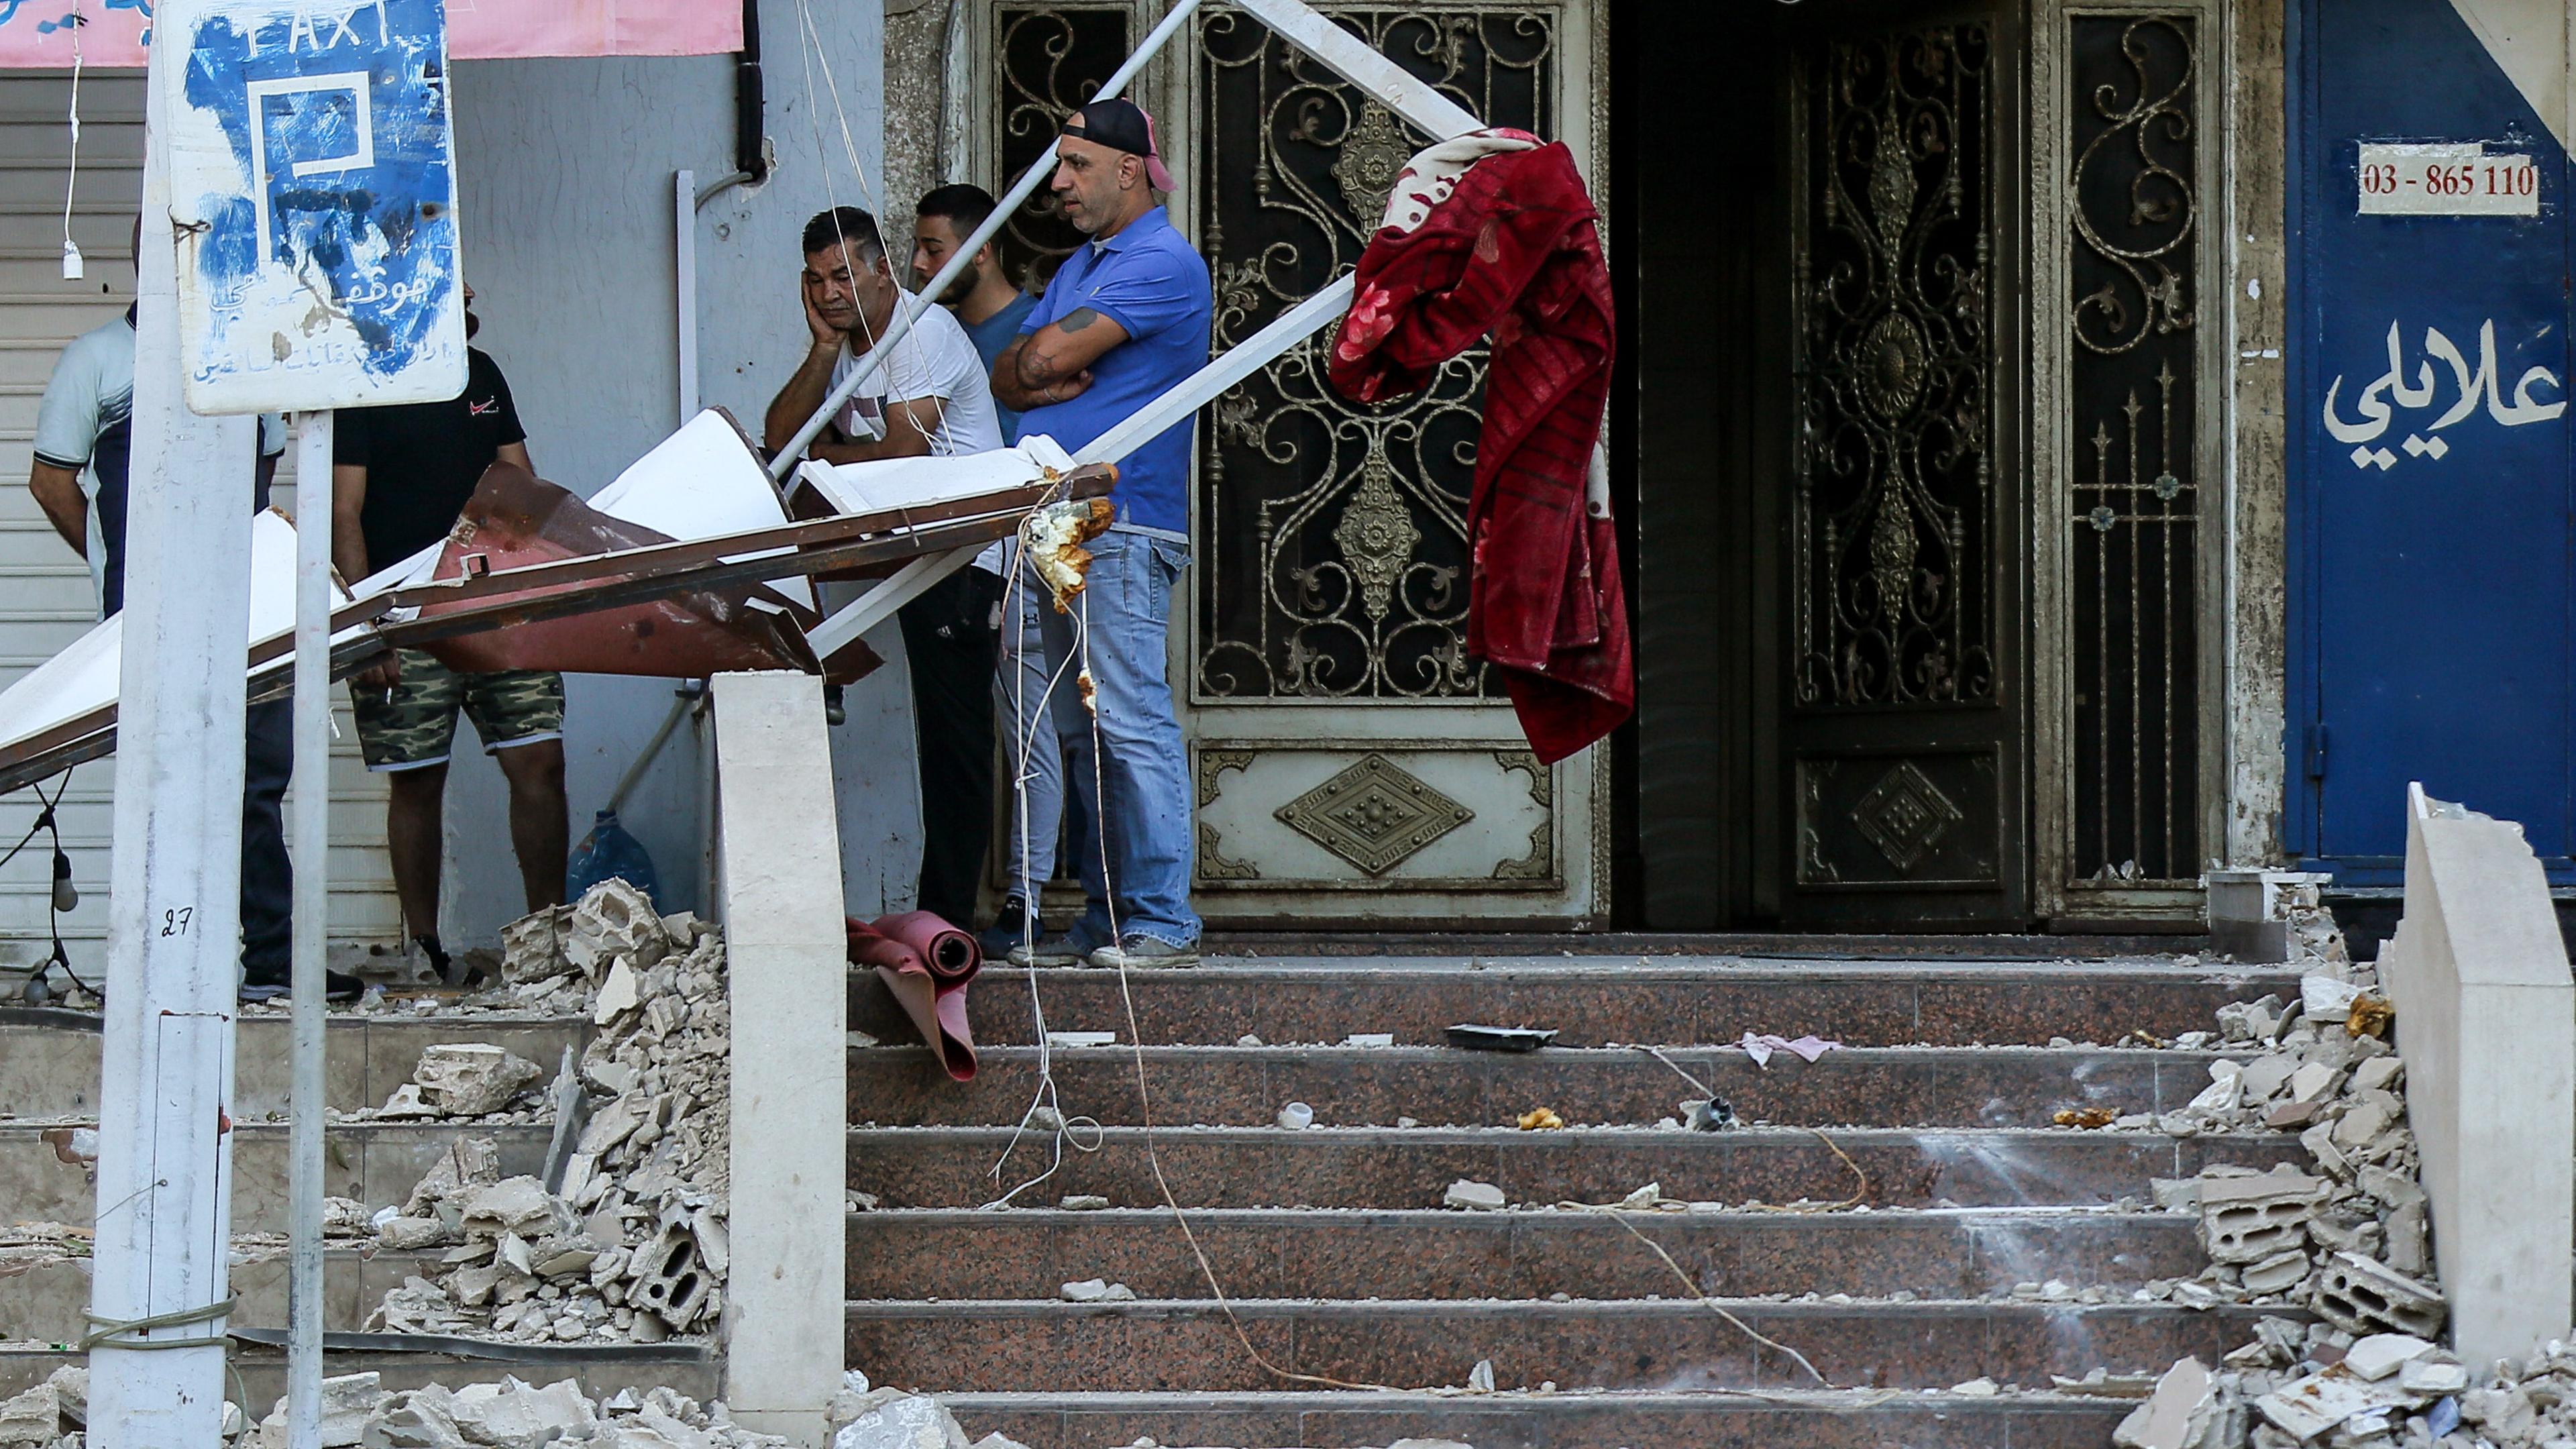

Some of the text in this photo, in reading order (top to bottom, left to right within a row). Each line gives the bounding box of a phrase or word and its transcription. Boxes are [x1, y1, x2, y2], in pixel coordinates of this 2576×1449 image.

[241, 0, 388, 57] TAXI
[2363, 164, 2397, 195] 03
[2426, 164, 2474, 195] 865
[2484, 165, 2533, 196] 110
[345, 266, 427, 315] موقف
[2322, 317, 2567, 472] علايلي
[161, 906, 193, 938] 27
